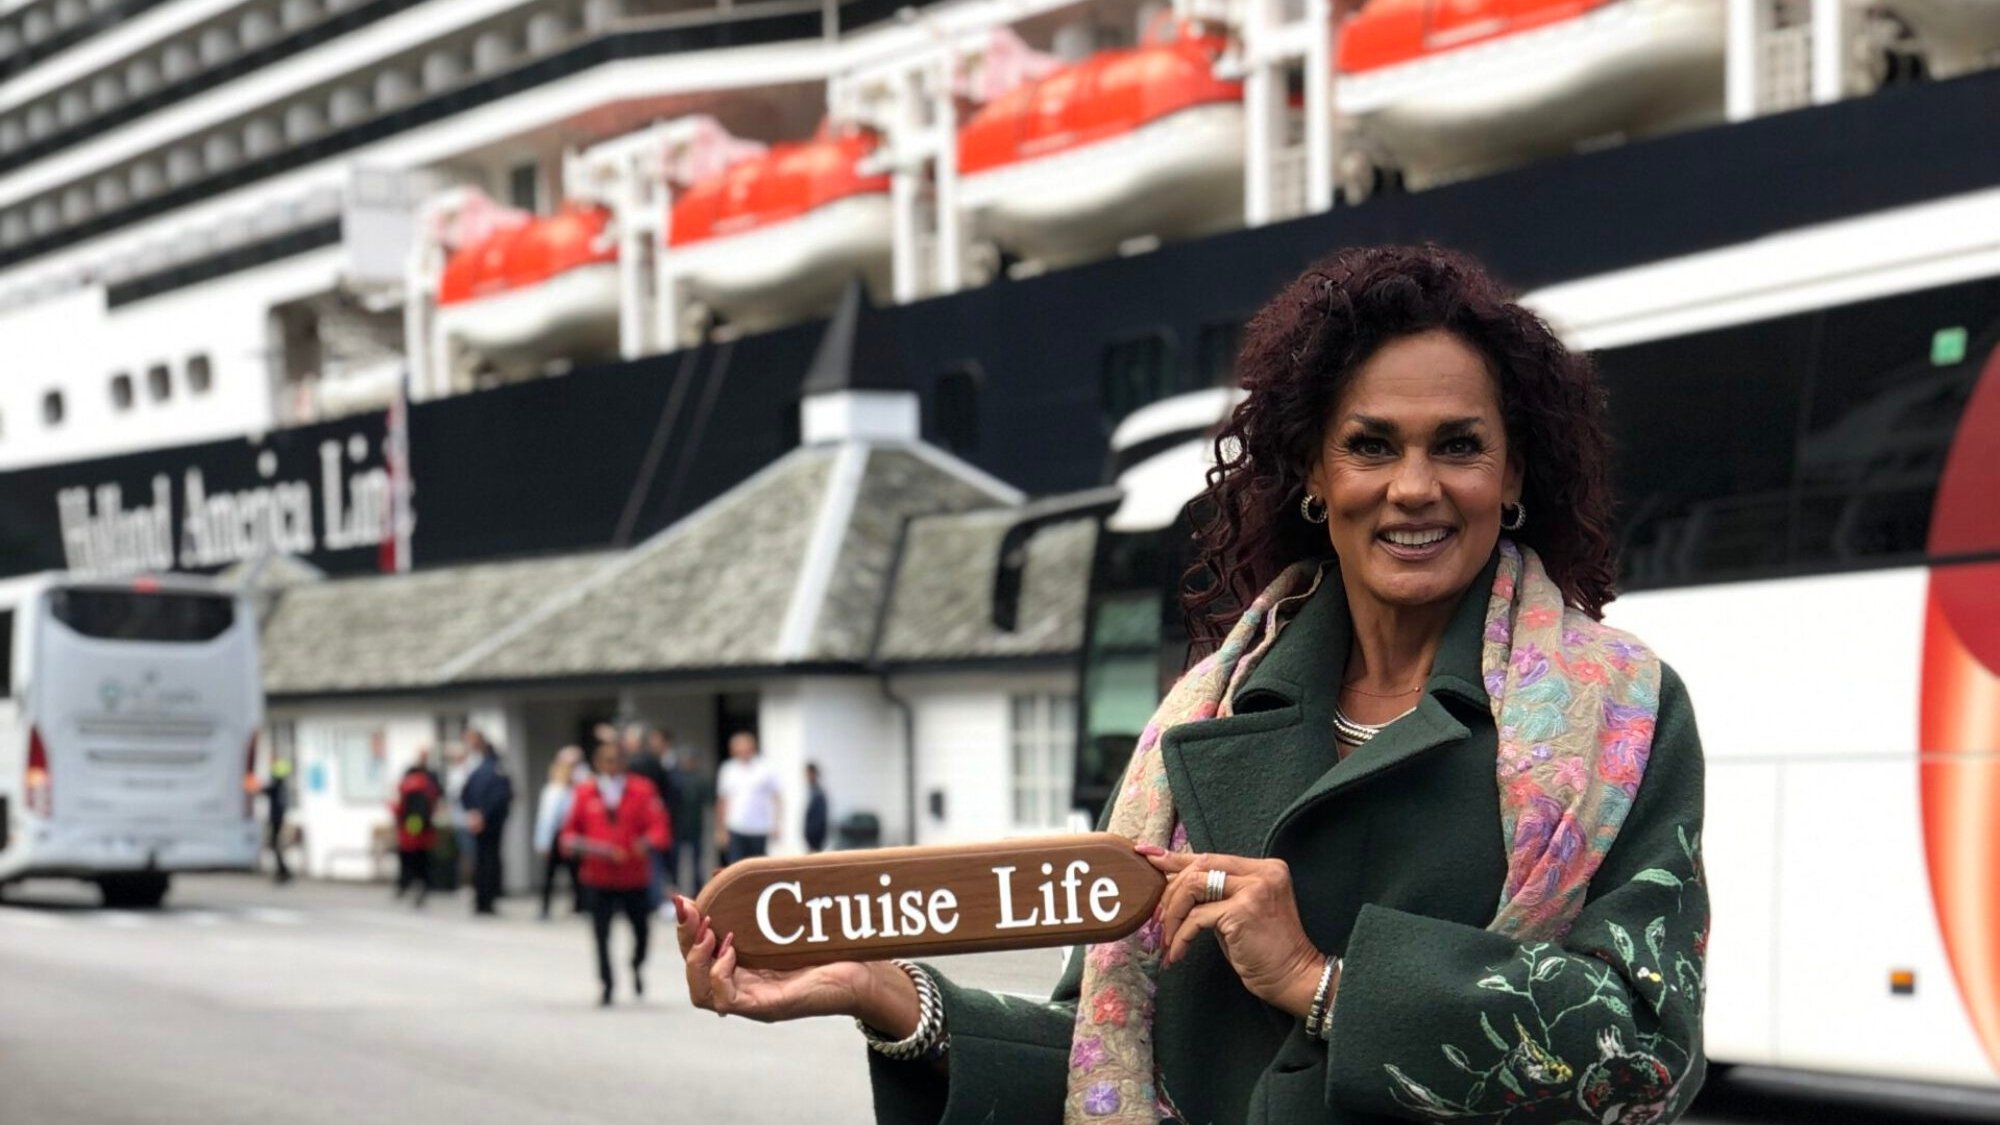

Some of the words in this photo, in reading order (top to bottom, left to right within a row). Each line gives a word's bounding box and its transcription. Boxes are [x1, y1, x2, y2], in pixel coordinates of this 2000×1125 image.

[180, 449, 315, 567] America
[756, 874, 959, 945] Cruise
[992, 860, 1121, 930] Life
